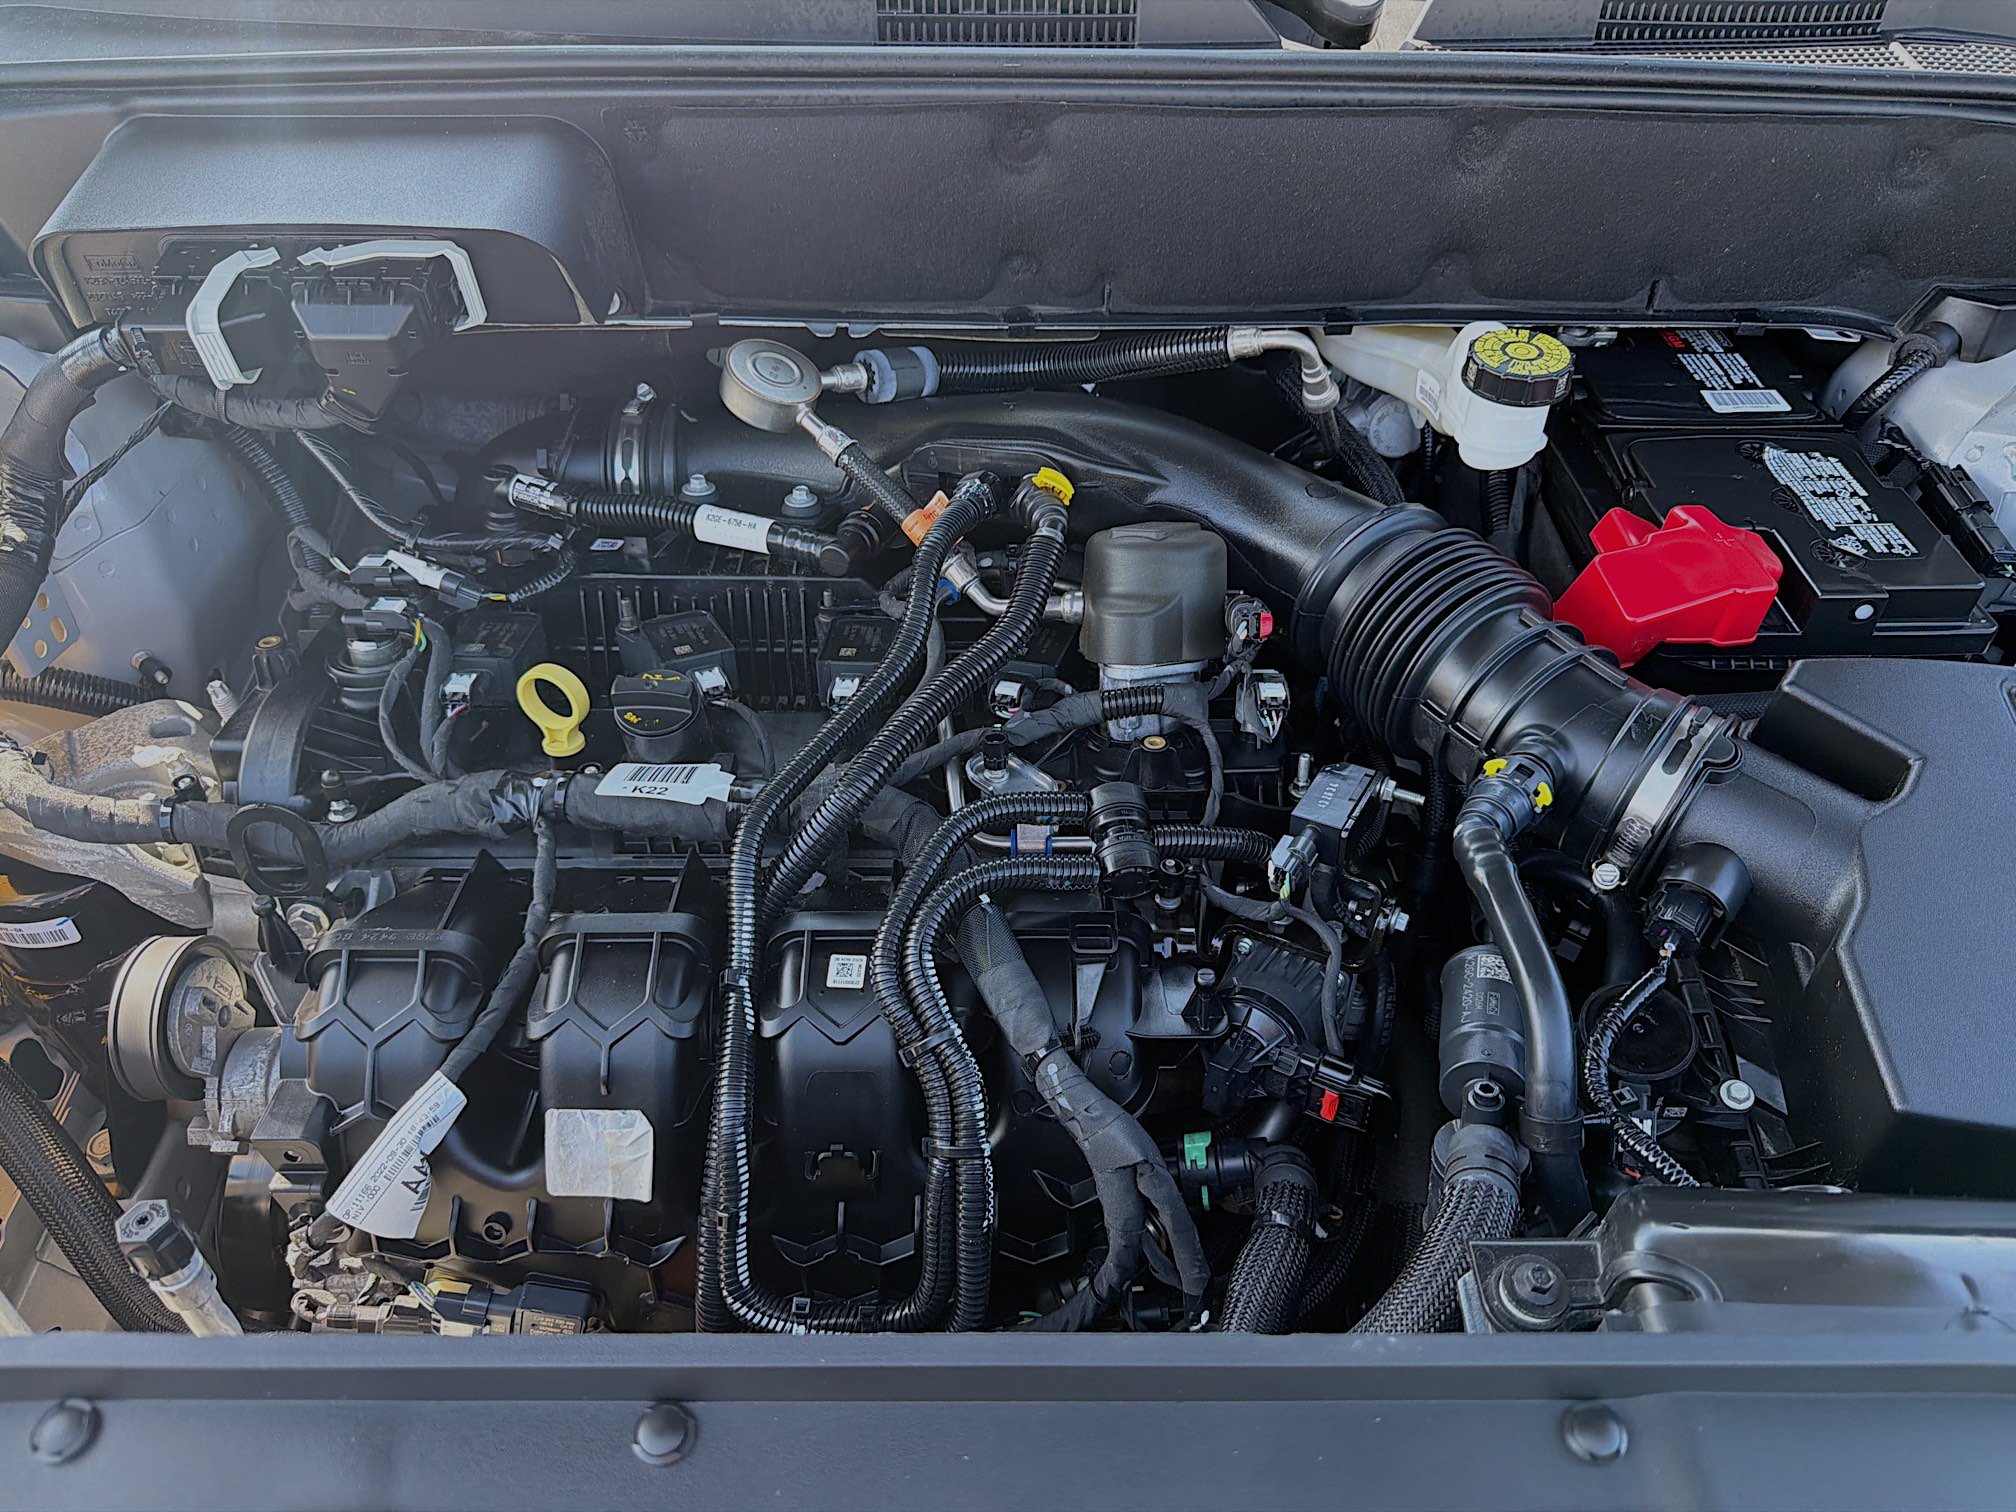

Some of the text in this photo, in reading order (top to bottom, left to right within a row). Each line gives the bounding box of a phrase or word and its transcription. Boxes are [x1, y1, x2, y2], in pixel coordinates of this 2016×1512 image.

[631, 786, 668, 796] K22
[1461, 956, 1475, 1023] K2GC-2420-AJ
[371, 1137, 407, 1182] 2022-09-30
[352, 1206, 365, 1220] NIV
